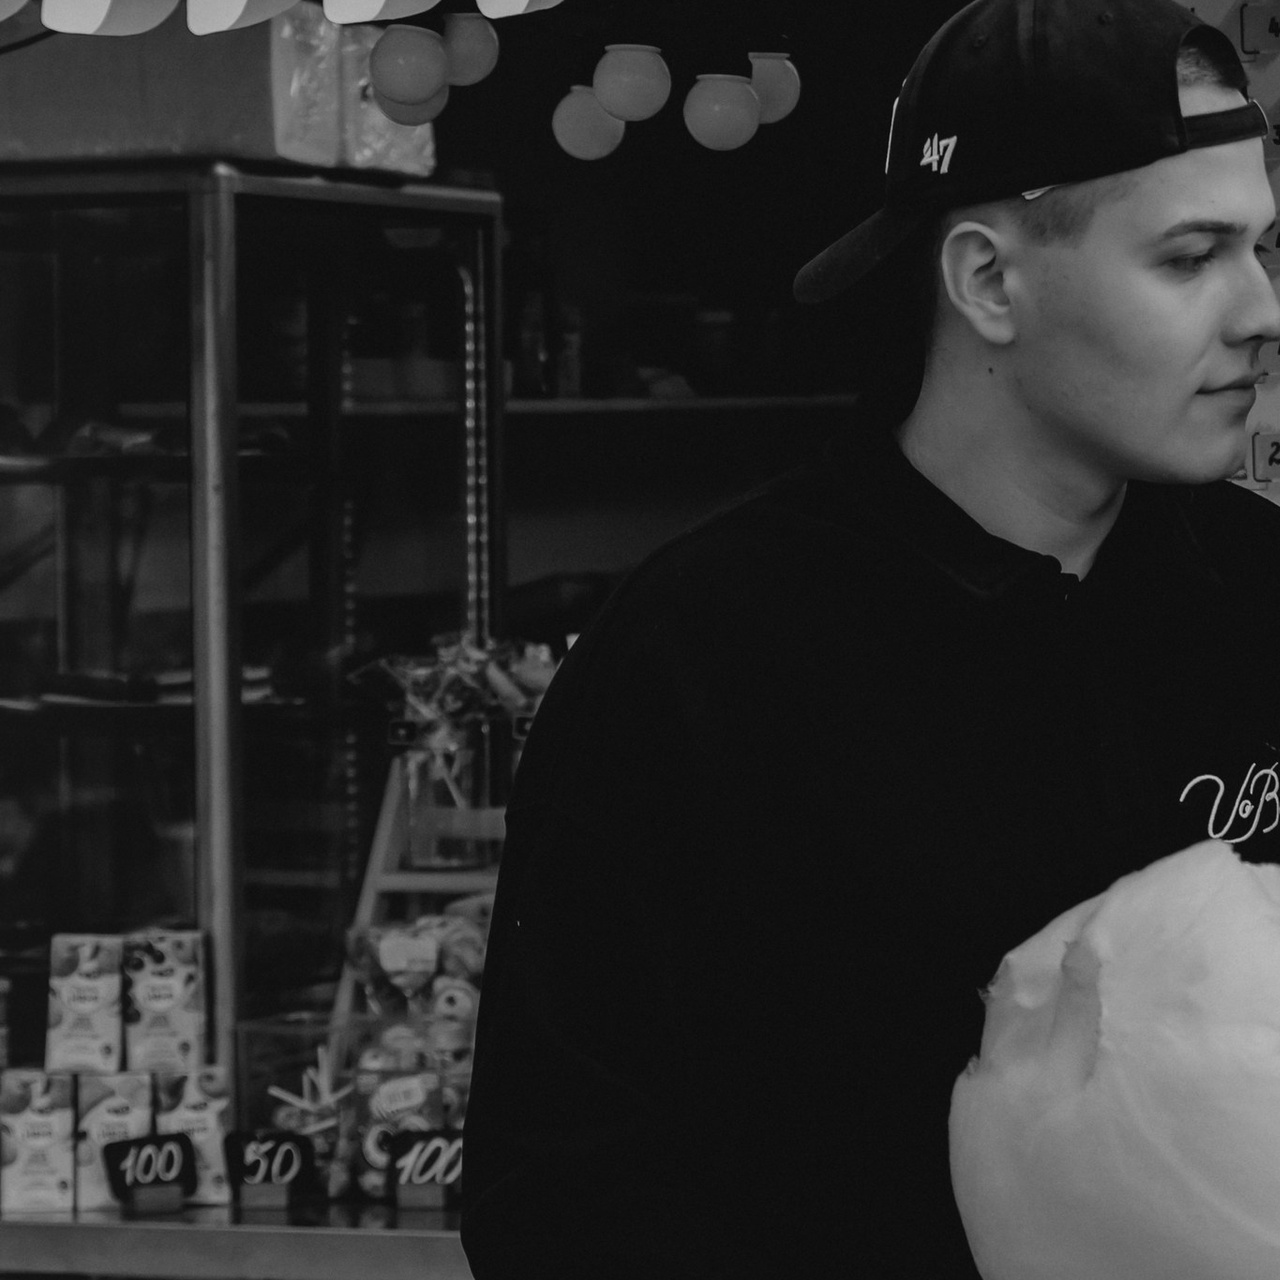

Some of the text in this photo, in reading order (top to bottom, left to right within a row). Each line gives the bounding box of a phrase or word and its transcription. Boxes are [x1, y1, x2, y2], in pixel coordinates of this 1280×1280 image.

[920, 132, 958, 175] 47
[119, 1141, 182, 1187] 100
[243, 1141, 300, 1184] 50
